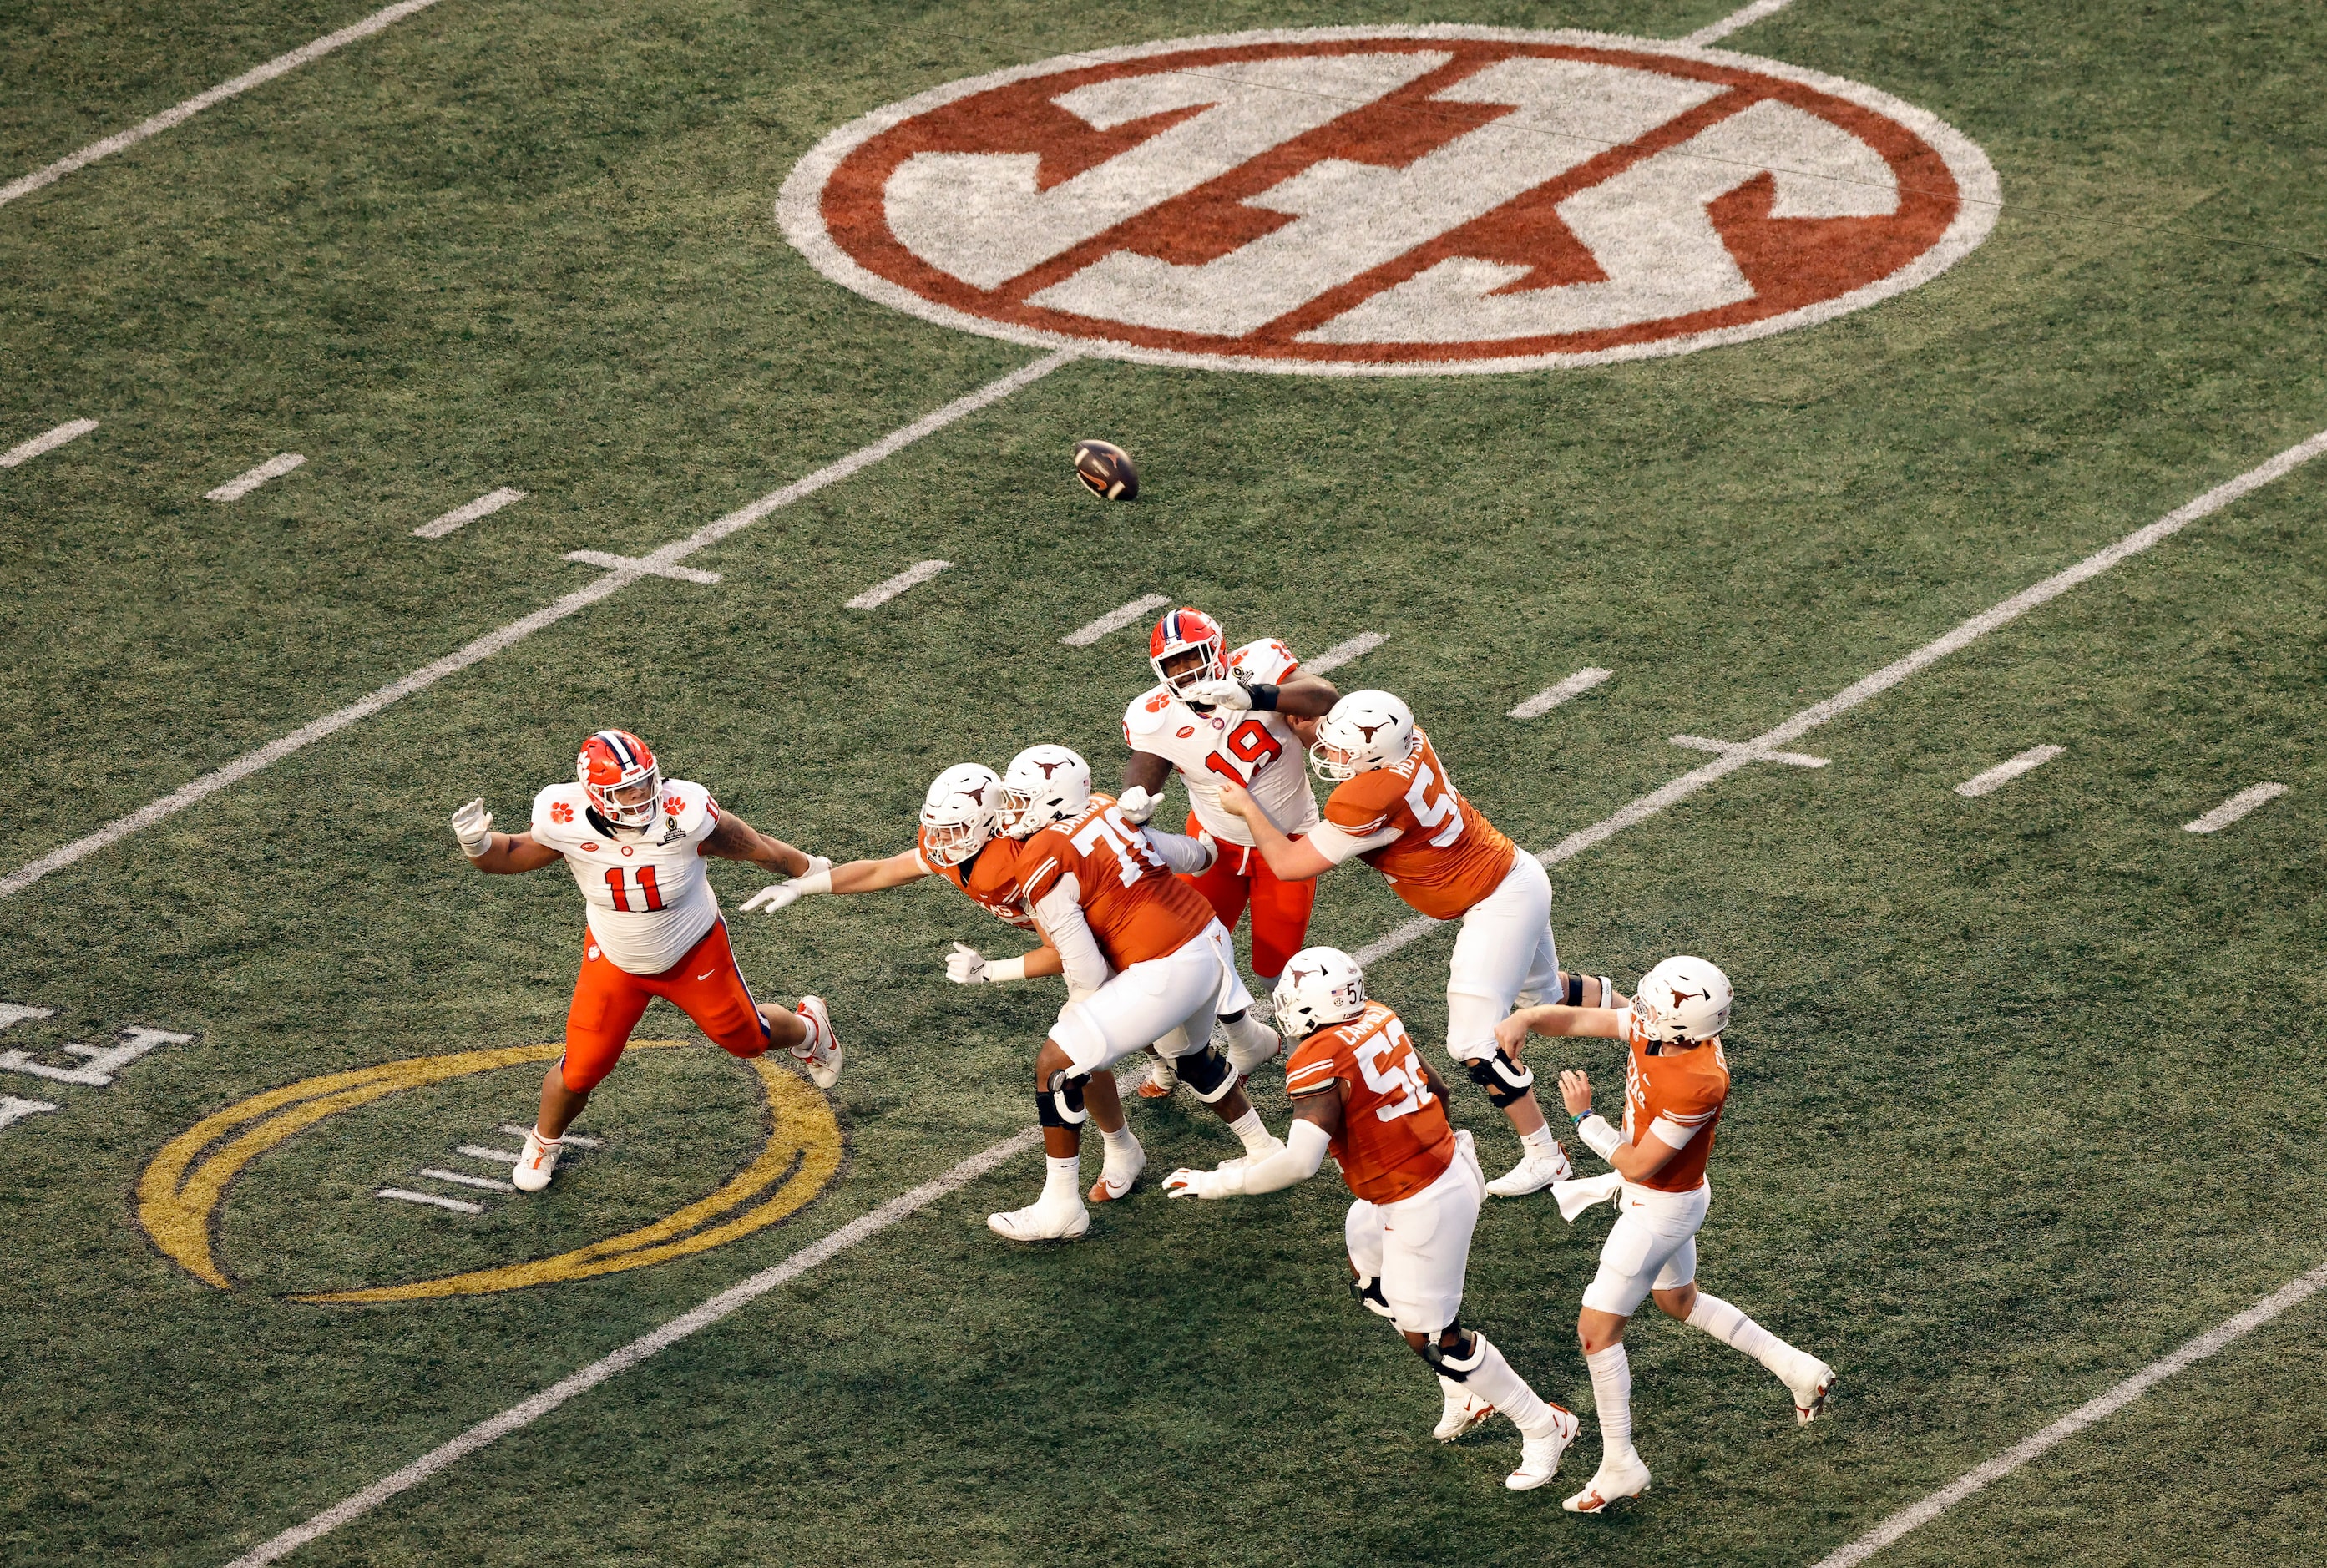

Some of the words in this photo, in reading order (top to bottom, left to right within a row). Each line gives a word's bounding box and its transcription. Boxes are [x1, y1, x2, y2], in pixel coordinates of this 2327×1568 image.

[1178, 726, 1192, 736] ACC
[1205, 719, 1283, 787] 19
[605, 865, 668, 913] 11
[1346, 979, 1364, 1005] 52
[1353, 1017, 1434, 1123] 52
